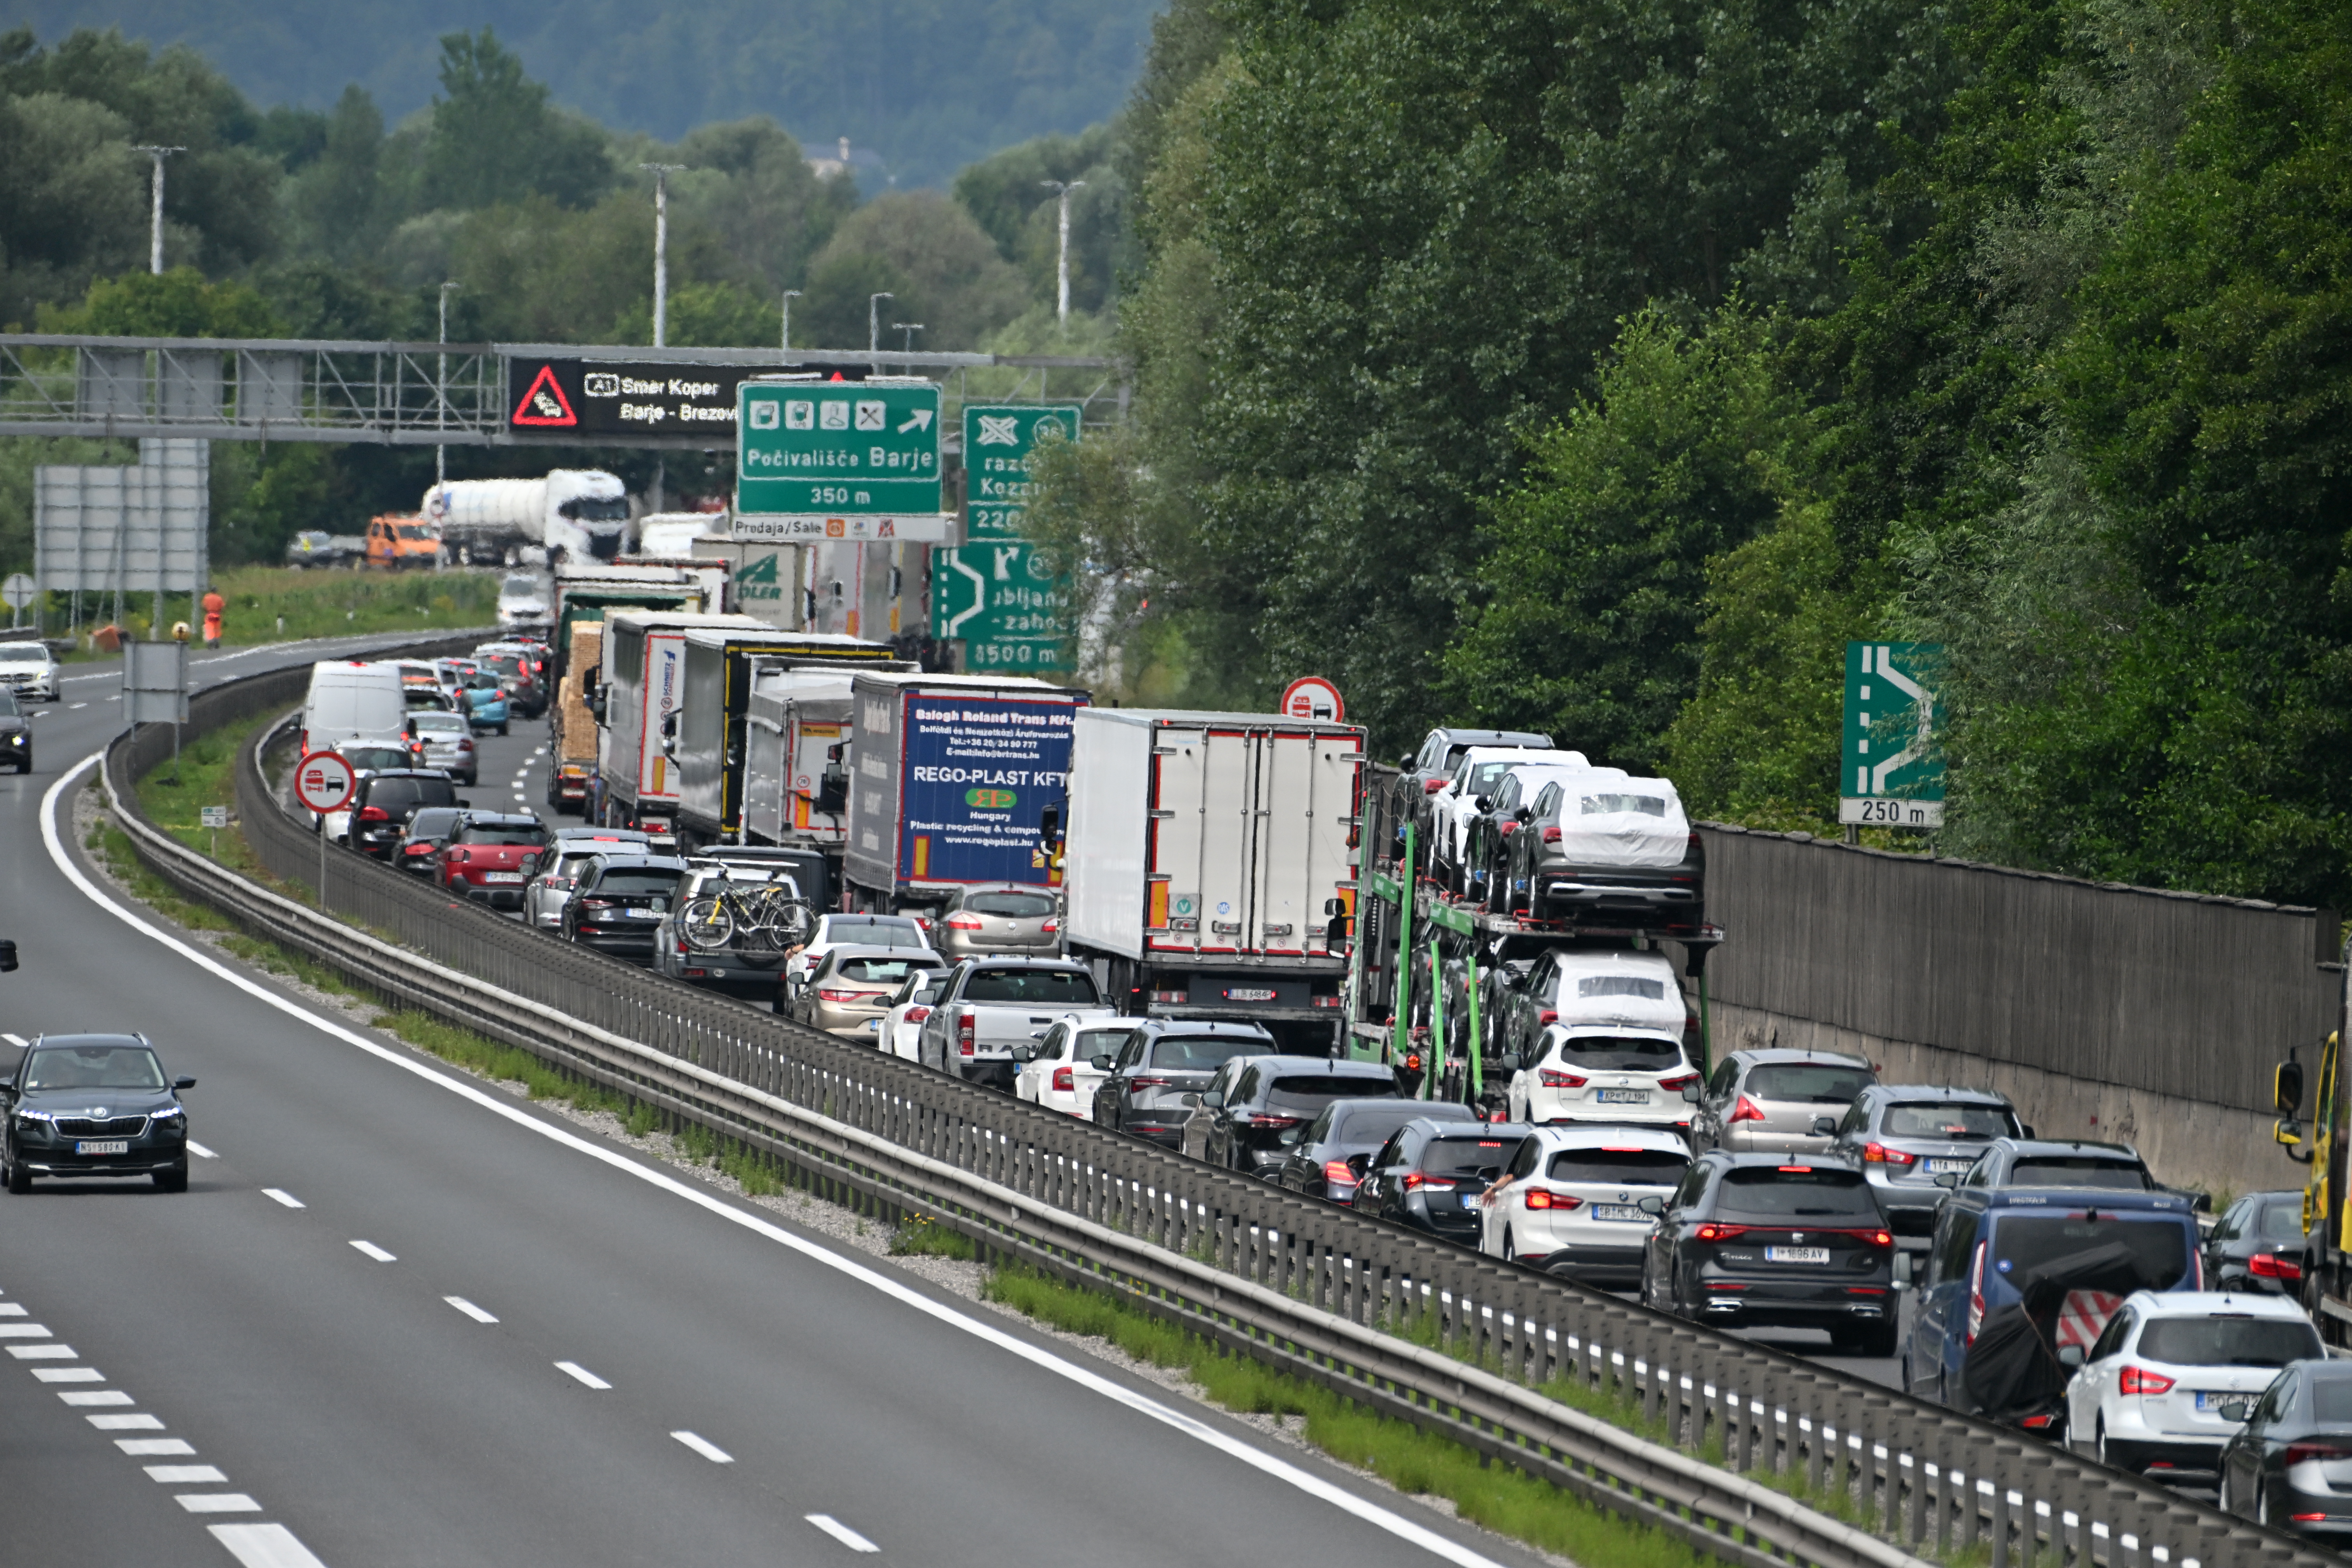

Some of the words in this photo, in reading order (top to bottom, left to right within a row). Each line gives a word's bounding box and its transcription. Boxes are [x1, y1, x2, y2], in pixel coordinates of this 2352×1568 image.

[621, 377, 665, 396] Smer
[668, 378, 721, 399] Koper
[620, 403, 665, 424] Barje
[747, 448, 859, 467] Počivališče
[870, 446, 933, 472] Barje
[810, 488, 848, 504] 350
[854, 491, 871, 505] m
[916, 709, 959, 722] Balogh
[962, 710, 1008, 723] Roland
[1010, 712, 1047, 726] Trans
[1049, 714, 1074, 726] Kft.
[965, 727, 1014, 737] Nemzetközi
[914, 766, 1029, 785] REGO-PLAST
[970, 812, 1011, 822] Hungary
[1862, 801, 1899, 821] 250
[1910, 809, 1924, 823] m
[910, 821, 943, 830] Plastic
[946, 823, 992, 834] recycling
[945, 836, 1034, 847] www.regoplast.hu
[1180, 902, 1189, 912] V
[1811, 1250, 1824, 1260] AV
